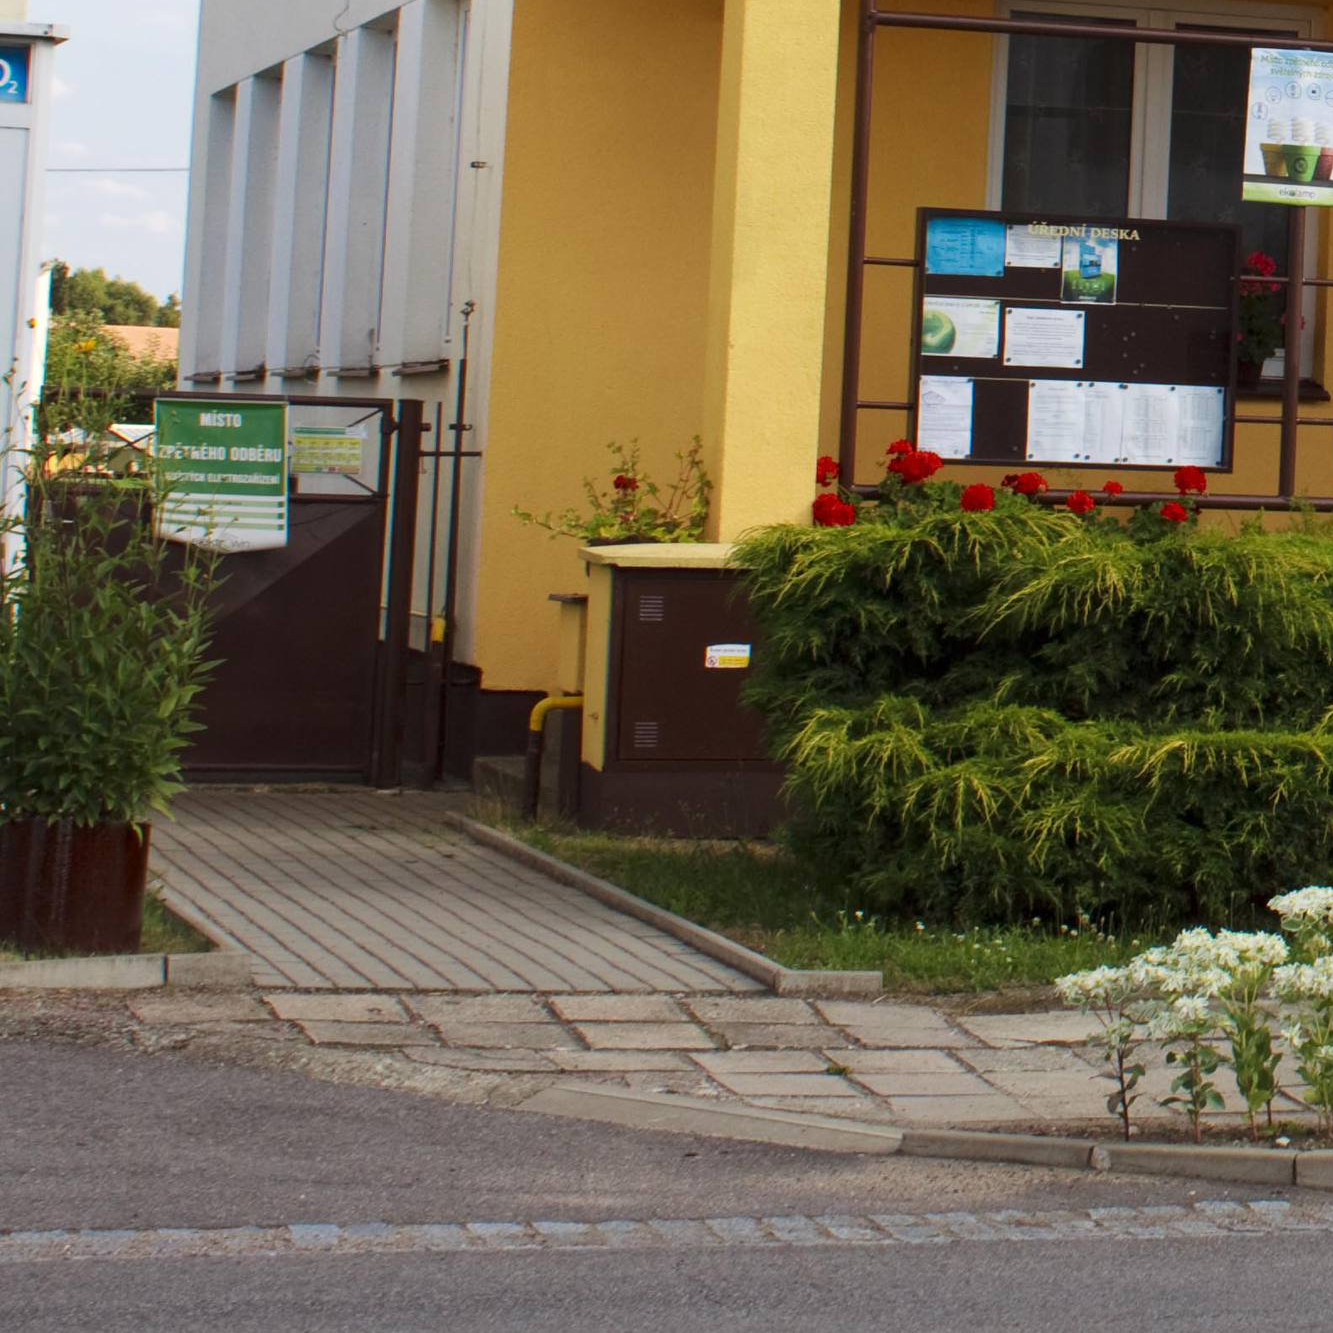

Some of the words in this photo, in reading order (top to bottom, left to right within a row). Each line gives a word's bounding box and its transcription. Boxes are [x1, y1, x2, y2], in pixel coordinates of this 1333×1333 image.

[1028, 221, 1087, 239] ÚŘEDNÍ
[1090, 226, 1141, 241] DESKA
[199, 410, 243, 428] MÍSTO
[229, 444, 283, 463] ODBĚRU
